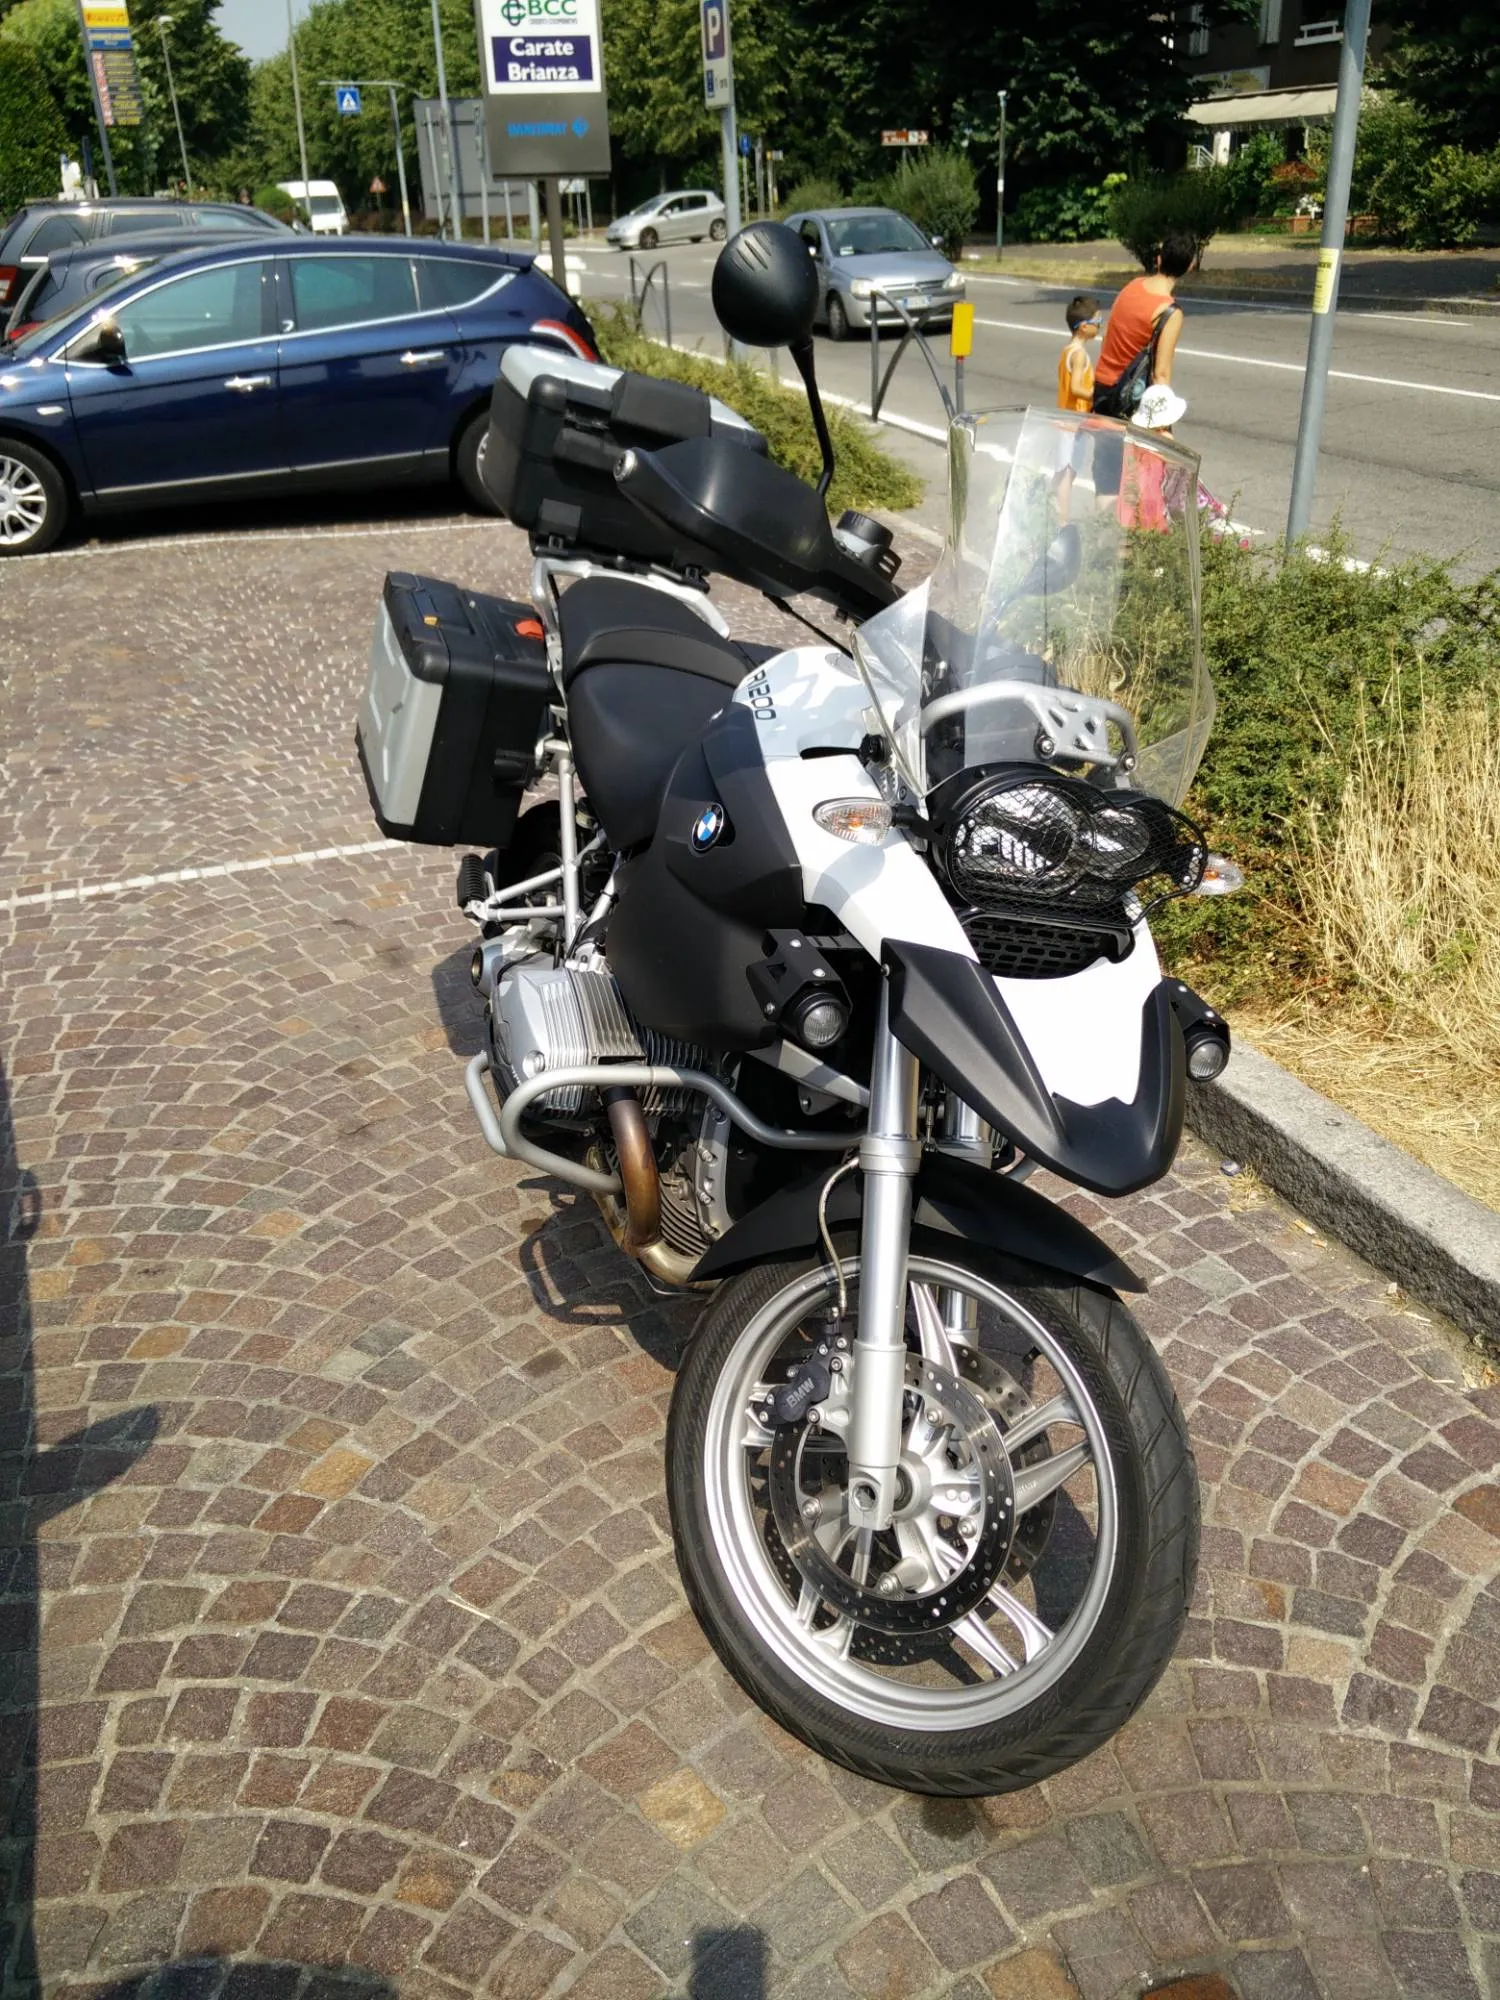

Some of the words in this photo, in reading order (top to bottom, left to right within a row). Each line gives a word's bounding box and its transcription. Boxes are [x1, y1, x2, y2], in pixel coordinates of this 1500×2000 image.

[528, 0, 577, 15] BCC
[707, 6, 721, 53] P
[509, 38, 575, 57] Carate
[507, 61, 580, 81] Brianza
[786, 1377, 815, 1408] BMW
